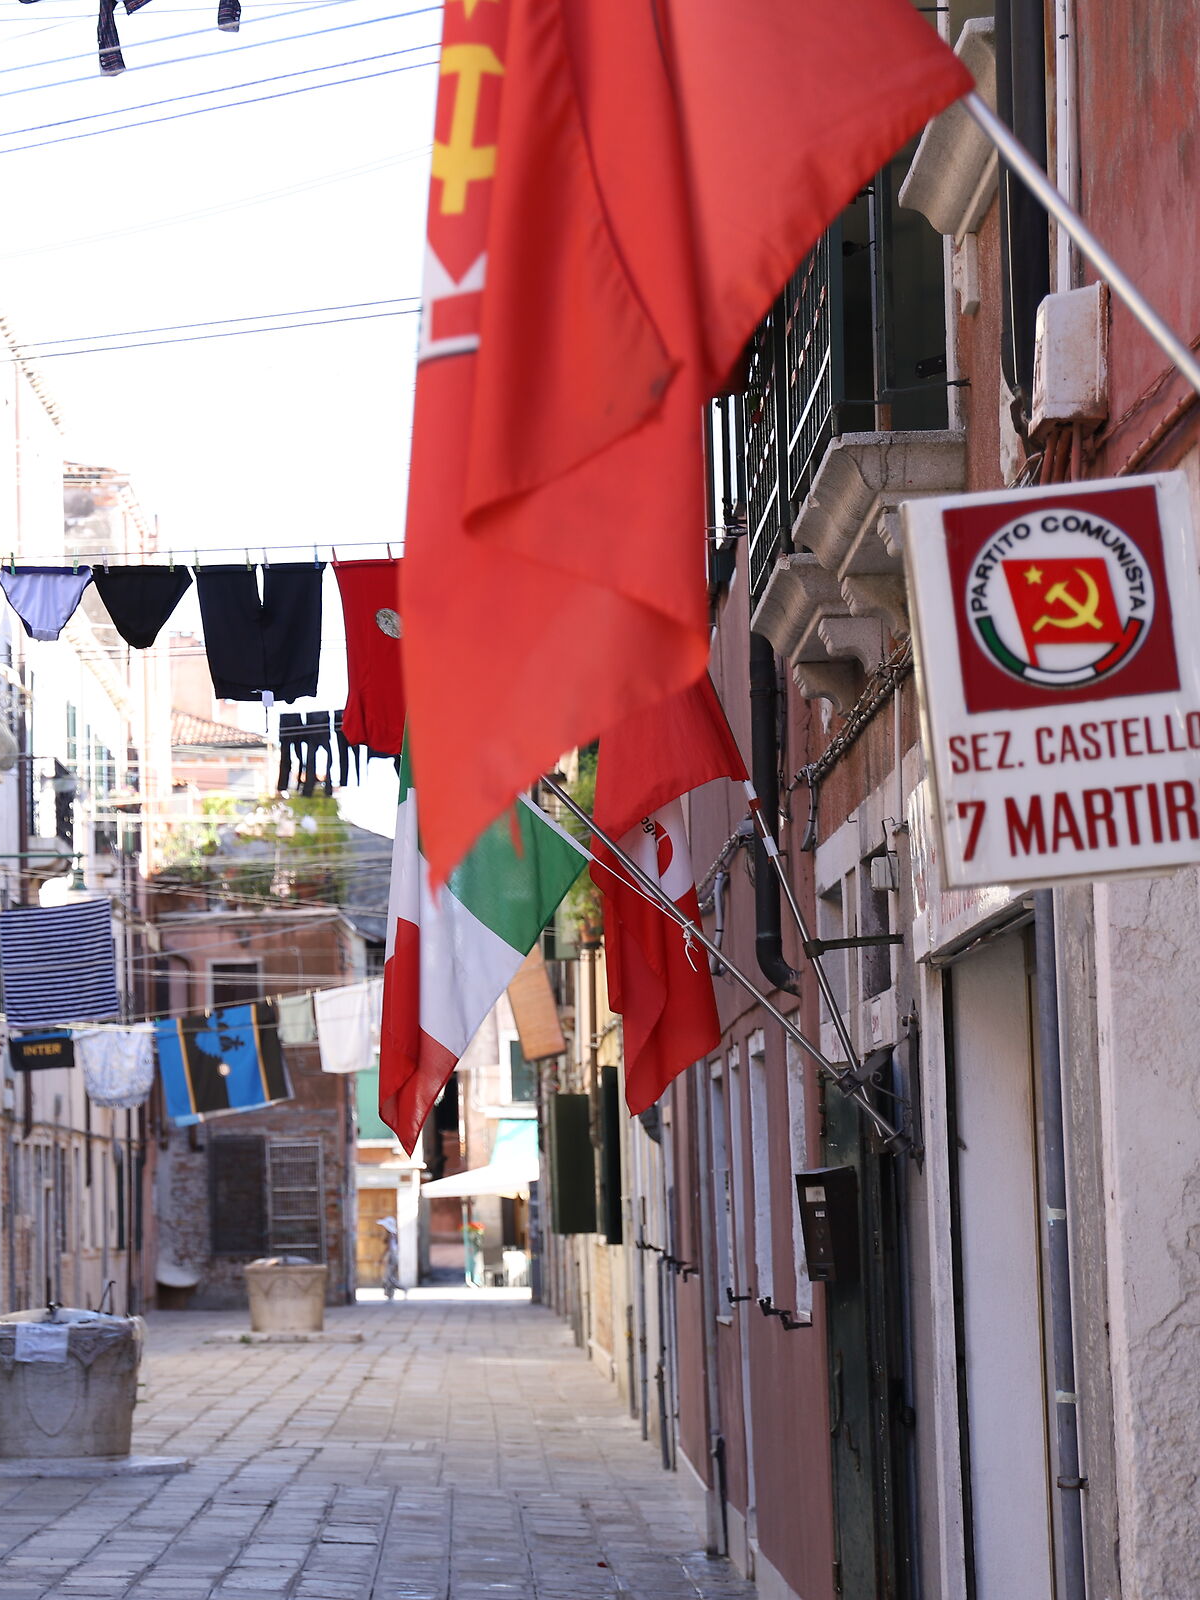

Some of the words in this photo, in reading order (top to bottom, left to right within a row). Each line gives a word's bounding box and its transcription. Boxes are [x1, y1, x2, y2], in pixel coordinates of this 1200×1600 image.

[972, 523, 1031, 612] PARTITO
[1041, 515, 1146, 612] COMUNISTA
[949, 730, 1024, 774] SEZ.
[1035, 711, 1200, 764] CASTELLO
[957, 800, 986, 862] 7
[1004, 778, 1200, 857] MARTIR
[22, 1043, 62, 1056] INTER
